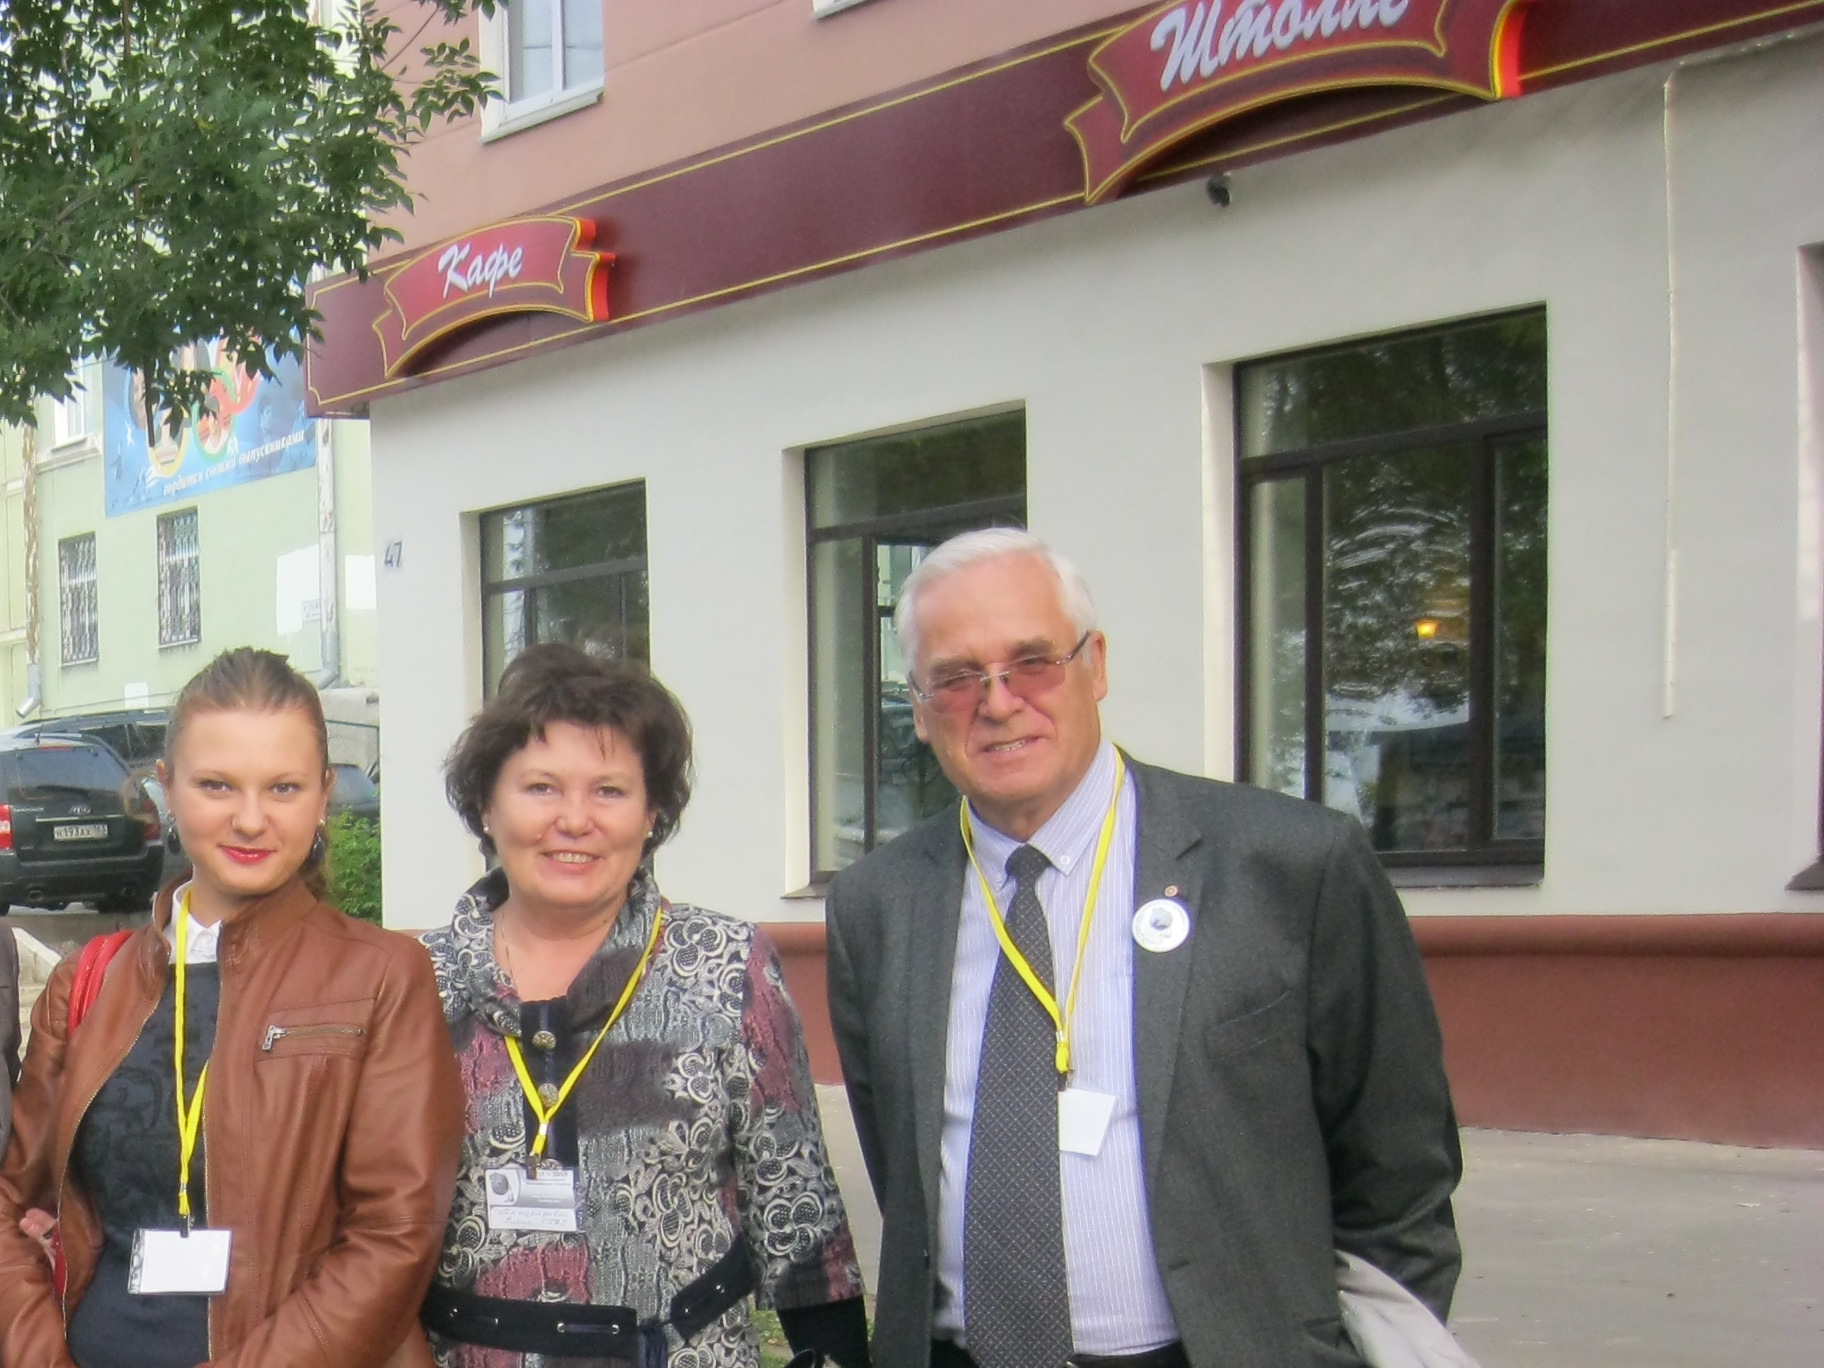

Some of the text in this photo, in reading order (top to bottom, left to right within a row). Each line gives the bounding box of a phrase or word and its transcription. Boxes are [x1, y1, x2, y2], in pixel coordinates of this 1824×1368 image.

[438, 242, 524, 299] Кафе
[238, 430, 306, 467] выпускниками
[384, 541, 403, 568] 47
